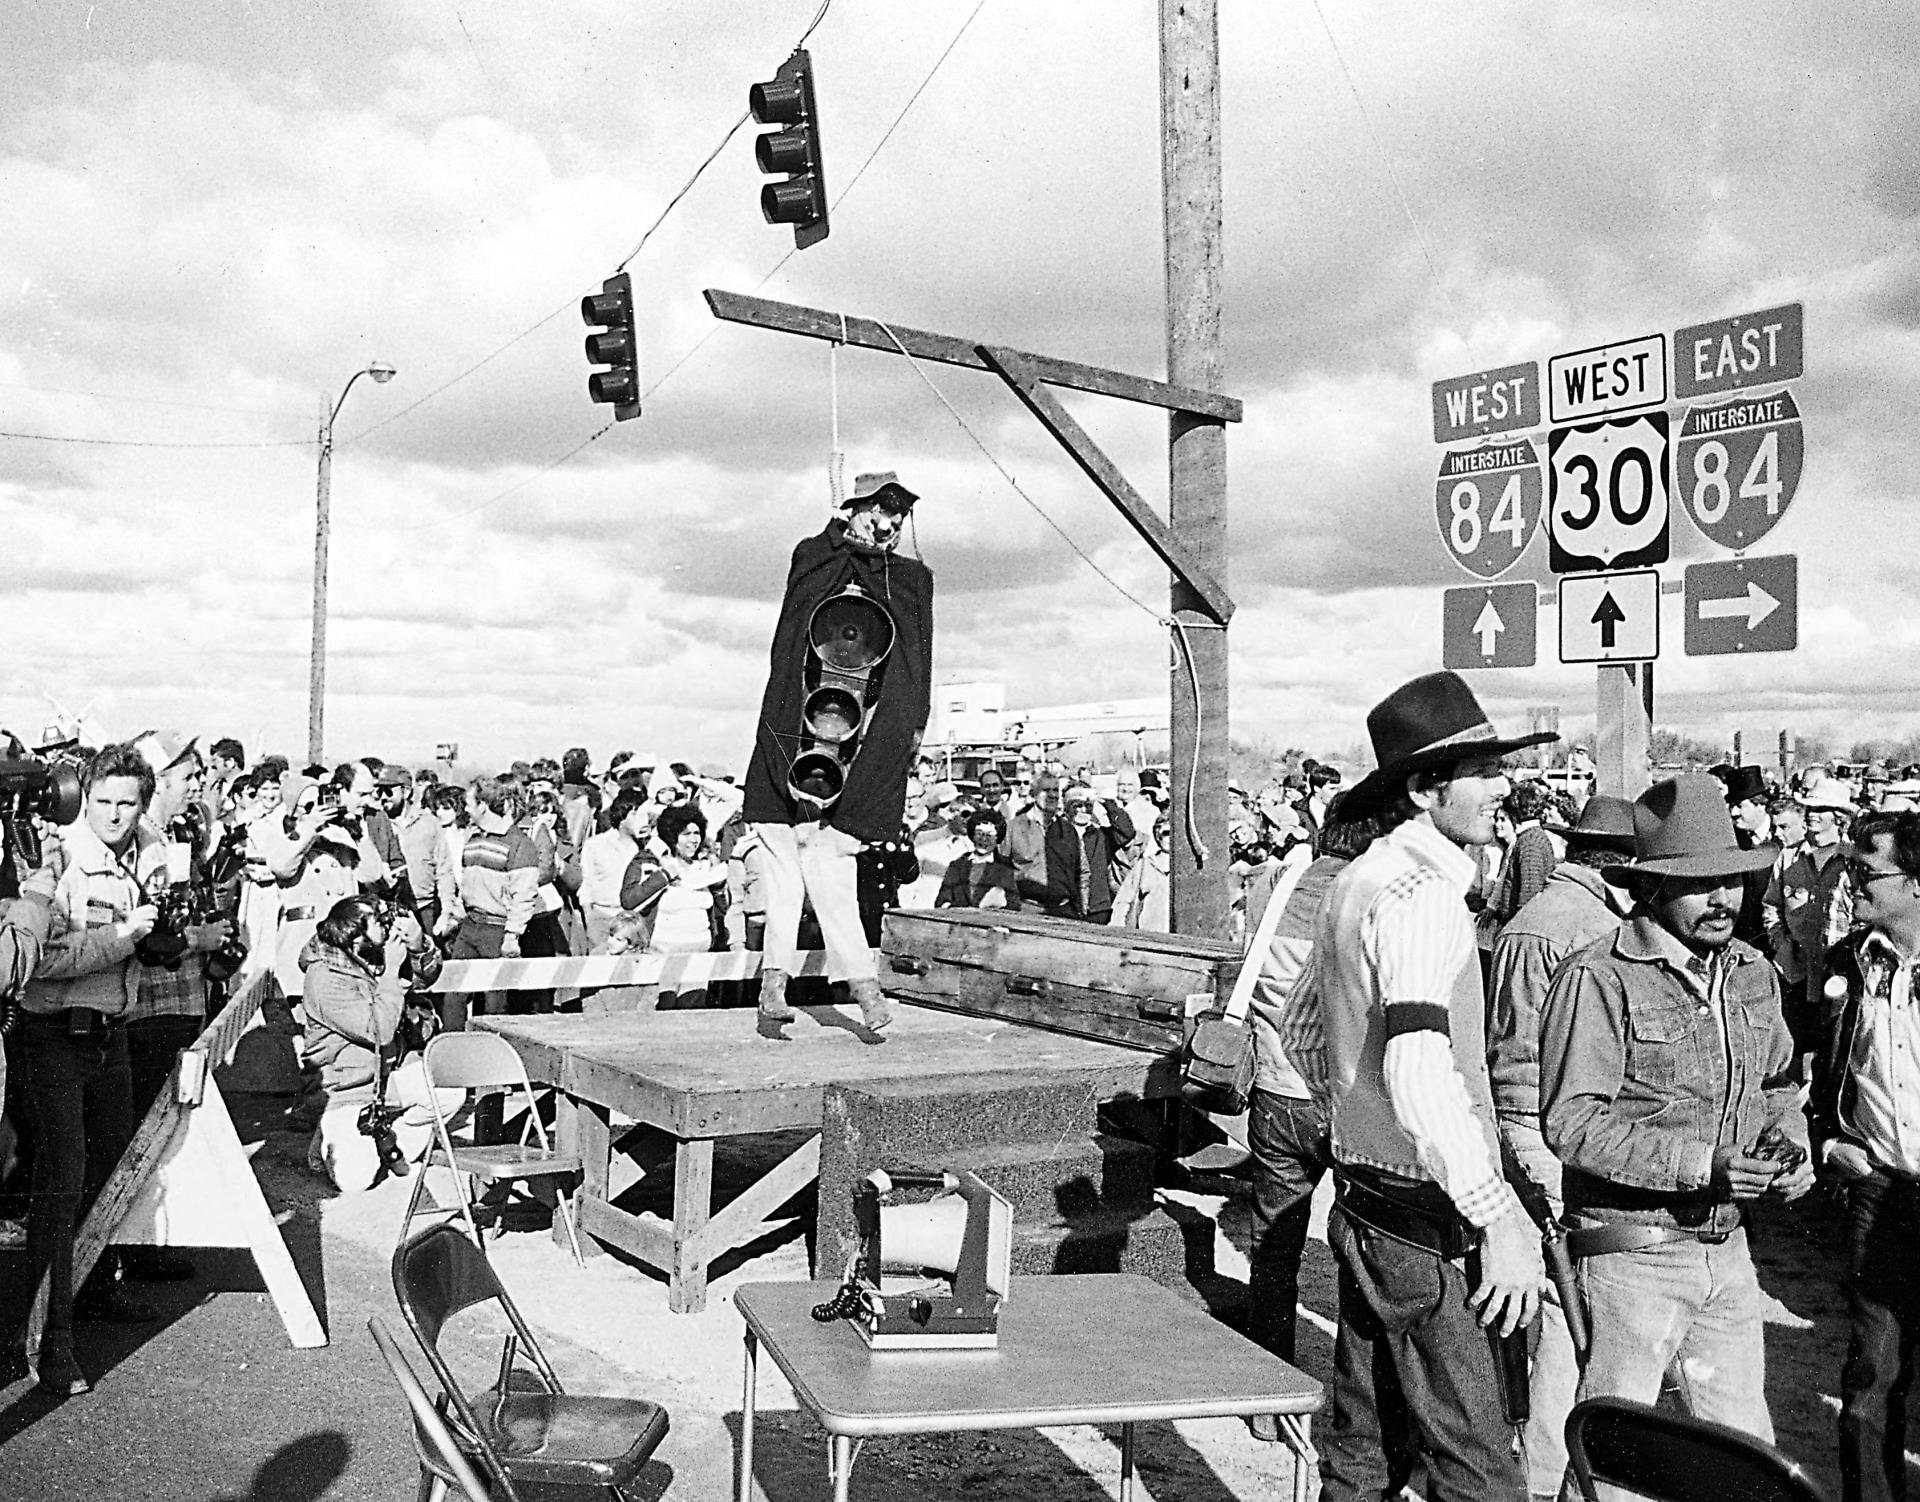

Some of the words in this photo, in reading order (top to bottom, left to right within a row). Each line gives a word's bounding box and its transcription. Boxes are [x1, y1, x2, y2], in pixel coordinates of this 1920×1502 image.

[1564, 353, 1649, 405] WEST
[1694, 324, 1782, 381] EAST
[1446, 379, 1525, 427] WEST
[1695, 400, 1782, 433] INTERSTATE
[1450, 446, 1525, 473] INTERSTATE
[1693, 432, 1783, 523] 84
[1450, 474, 1525, 554] 84
[1560, 447, 1653, 530] 30
